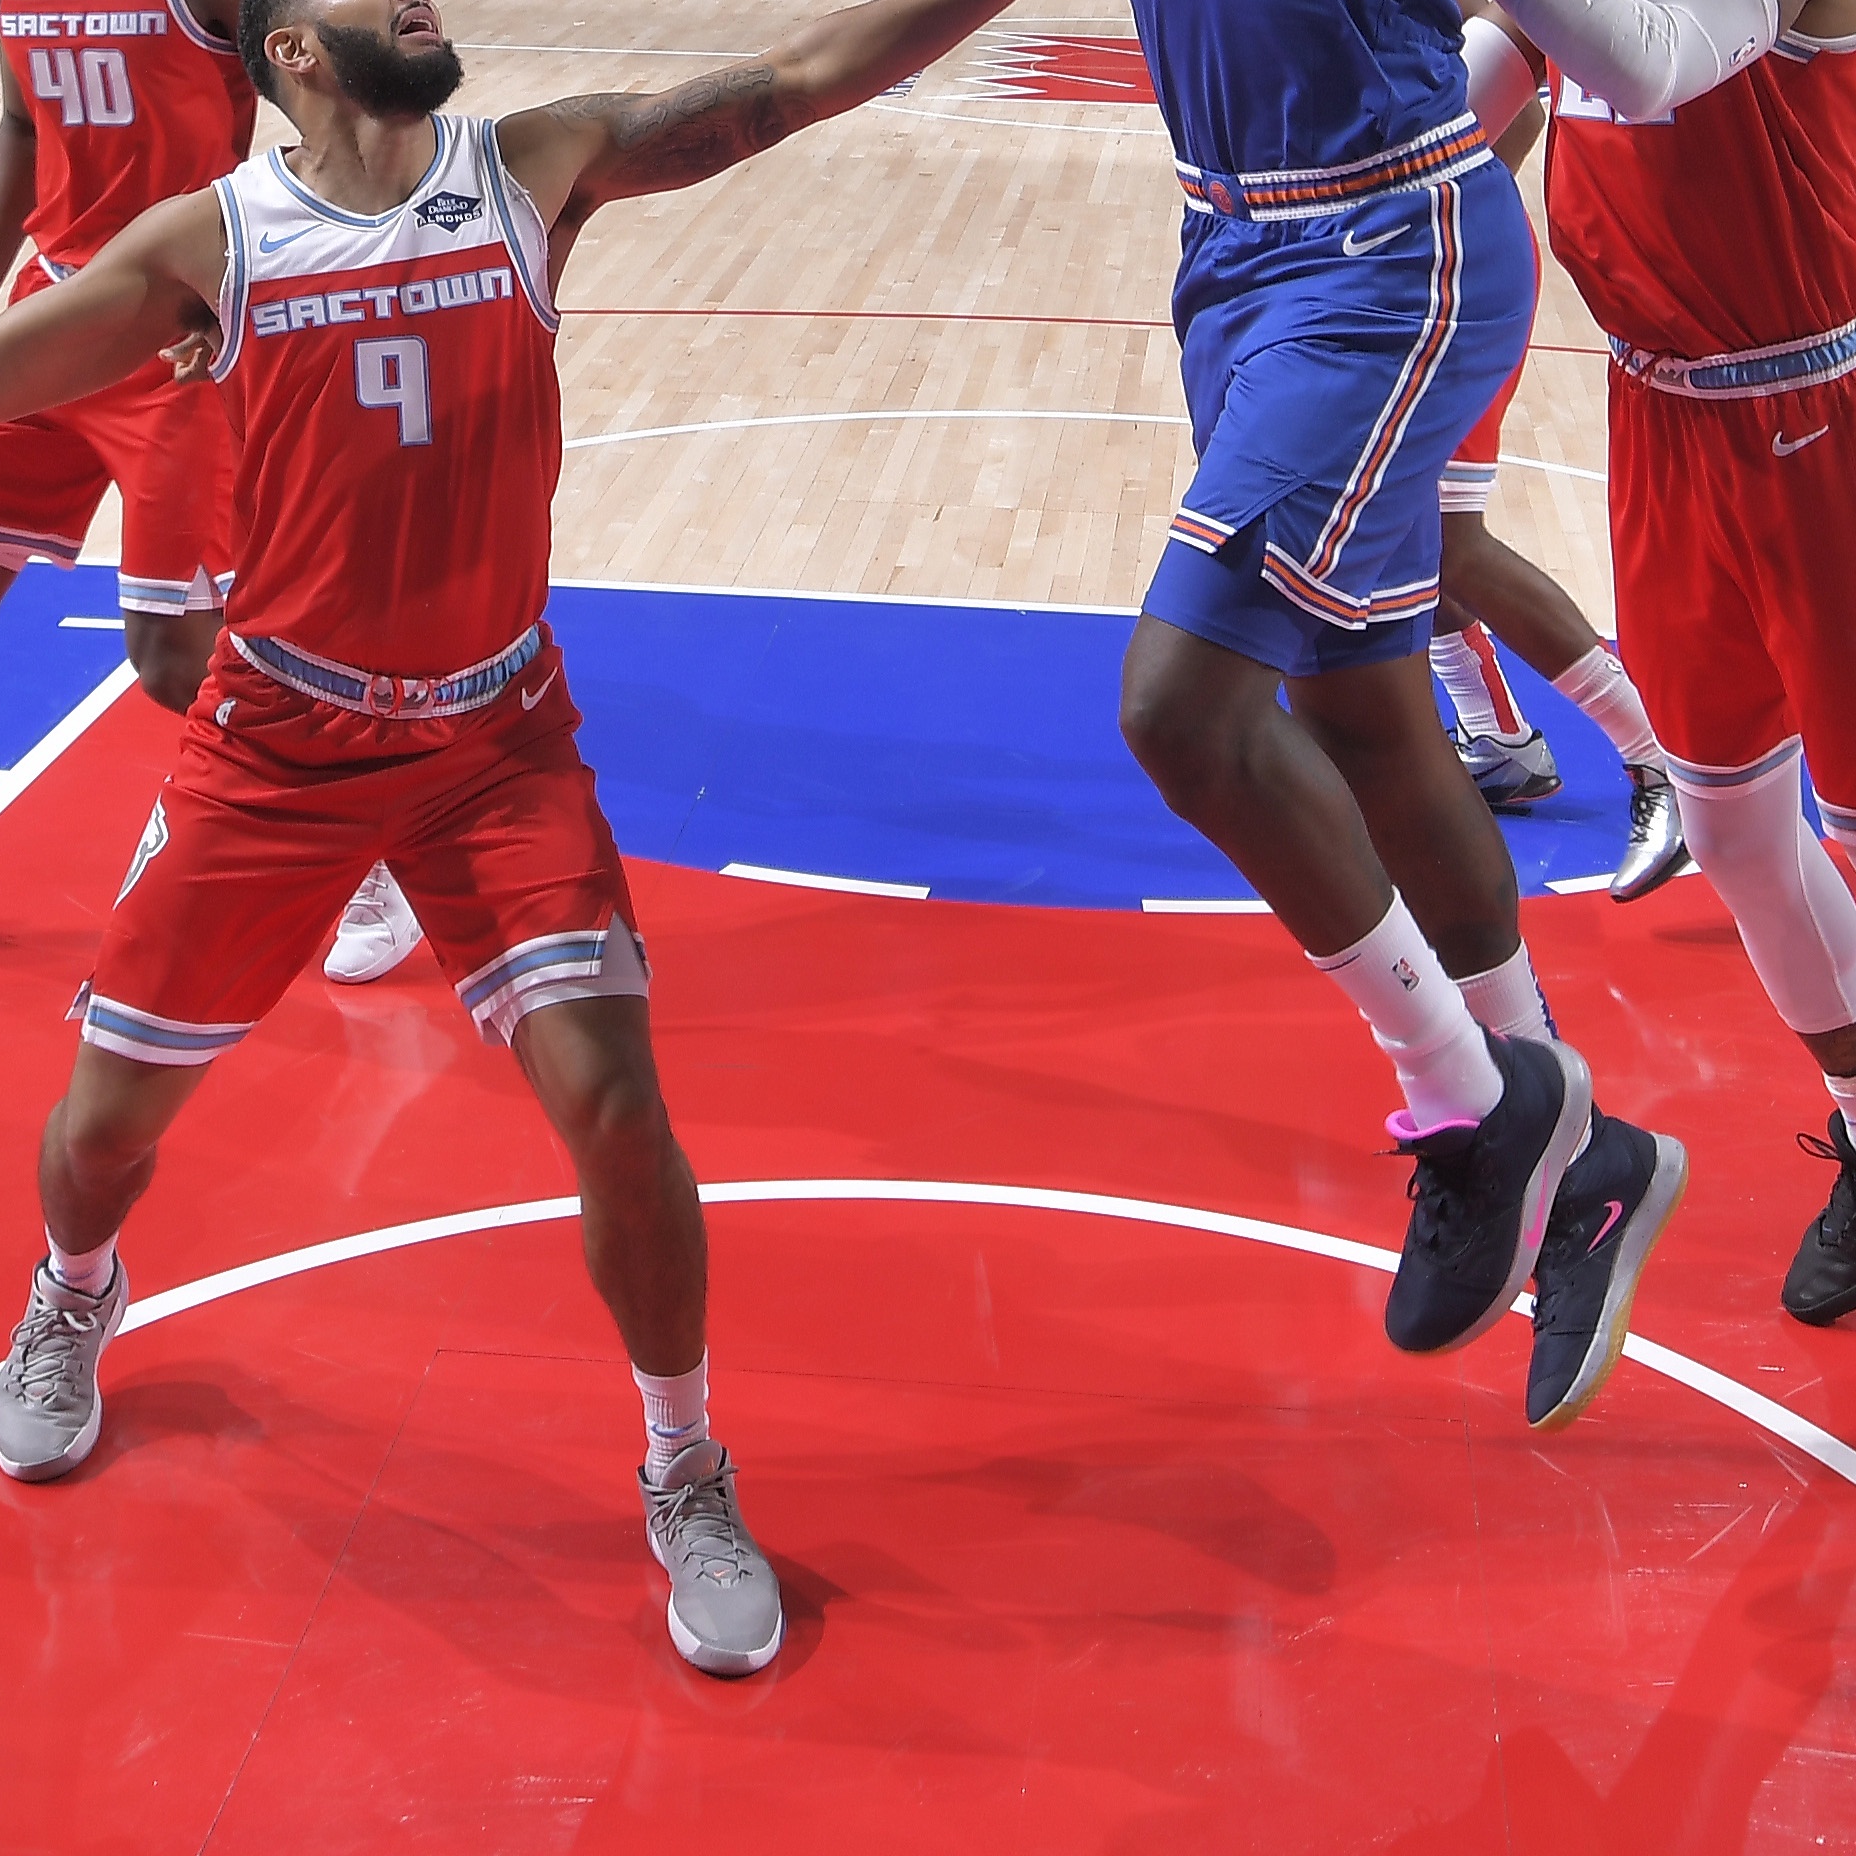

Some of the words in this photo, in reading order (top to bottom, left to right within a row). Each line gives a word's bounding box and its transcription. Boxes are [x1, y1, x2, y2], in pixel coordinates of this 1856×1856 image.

[0, 11, 168, 38] SACTOWN
[27, 48, 136, 127] 40
[415, 208, 482, 230] ALMONDS
[427, 201, 468, 216] DIAMOND
[251, 266, 515, 339] SACTOWN
[353, 334, 434, 447] 9
